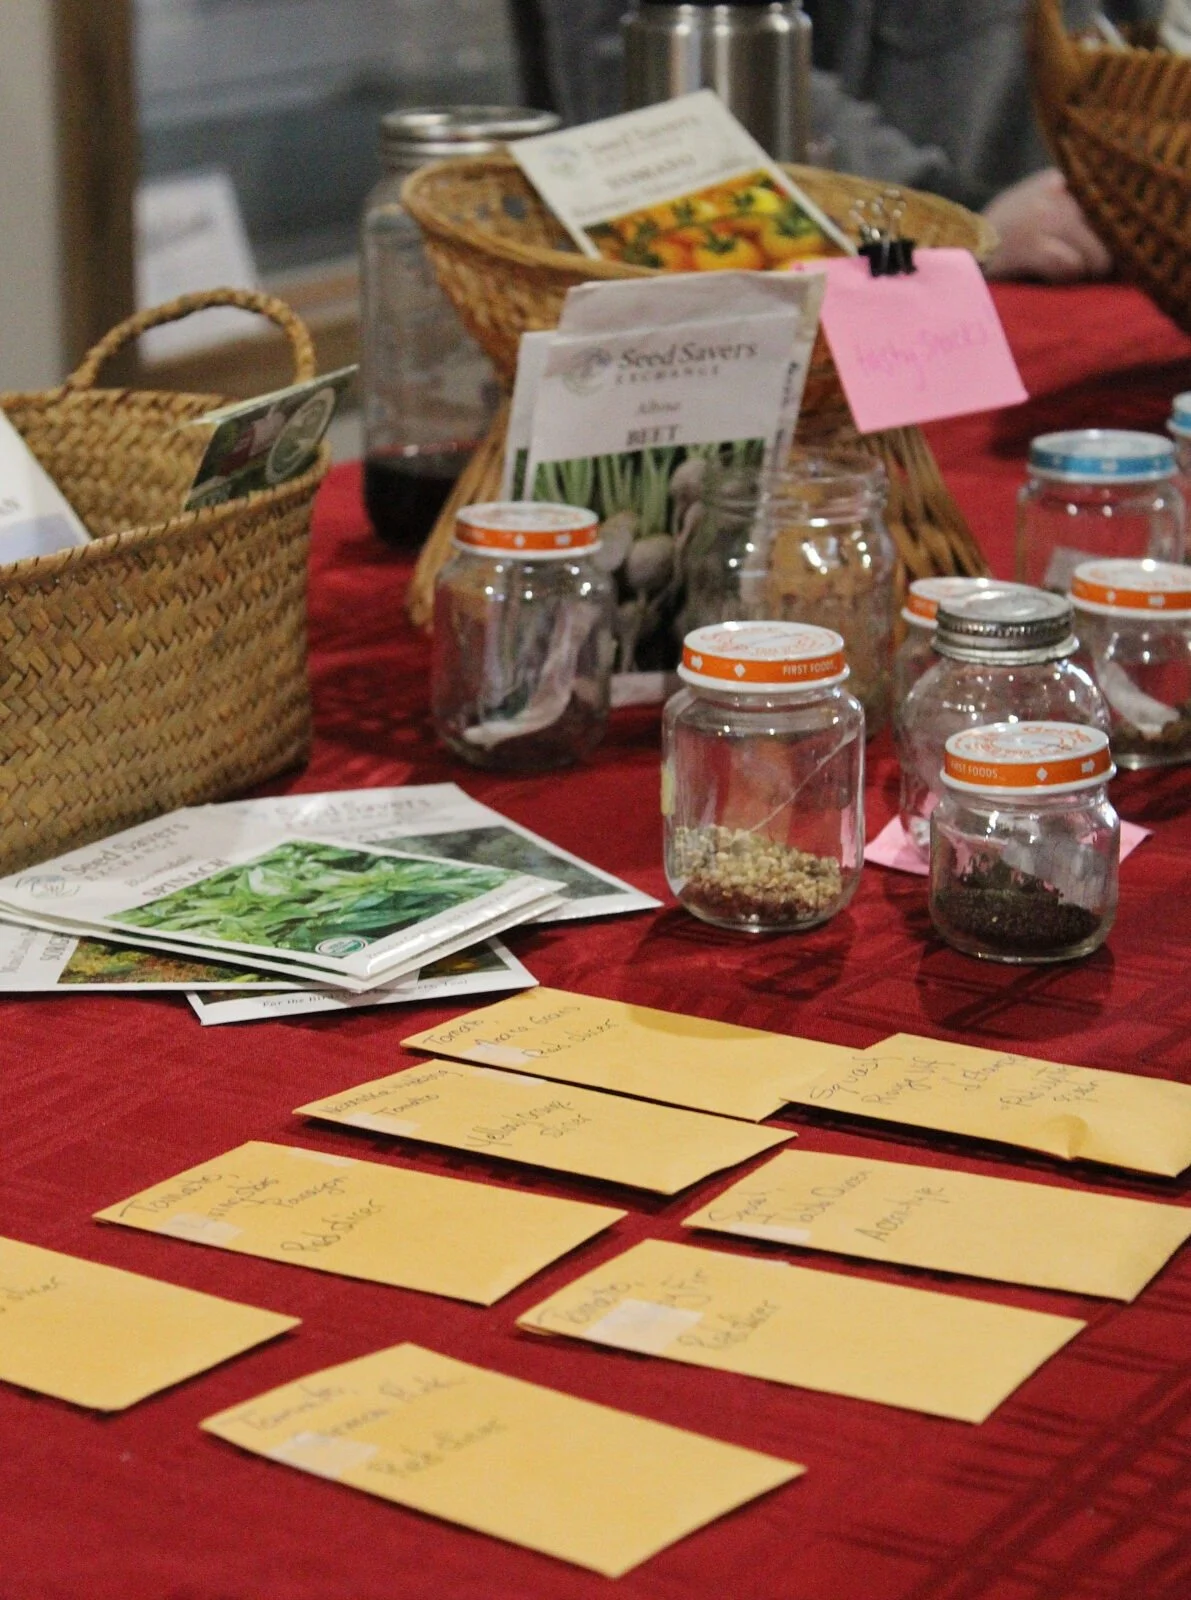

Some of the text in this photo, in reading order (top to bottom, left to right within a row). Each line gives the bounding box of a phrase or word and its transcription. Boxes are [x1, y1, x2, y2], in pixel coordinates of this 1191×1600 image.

[618, 341, 758, 370] Seed Savers
[625, 424, 680, 447] BEET
[782, 664, 808, 676] FIRST
[967, 764, 999, 779] FOODS
[61, 822, 190, 875] Seed Savers
[141, 857, 232, 898] SPINACH
